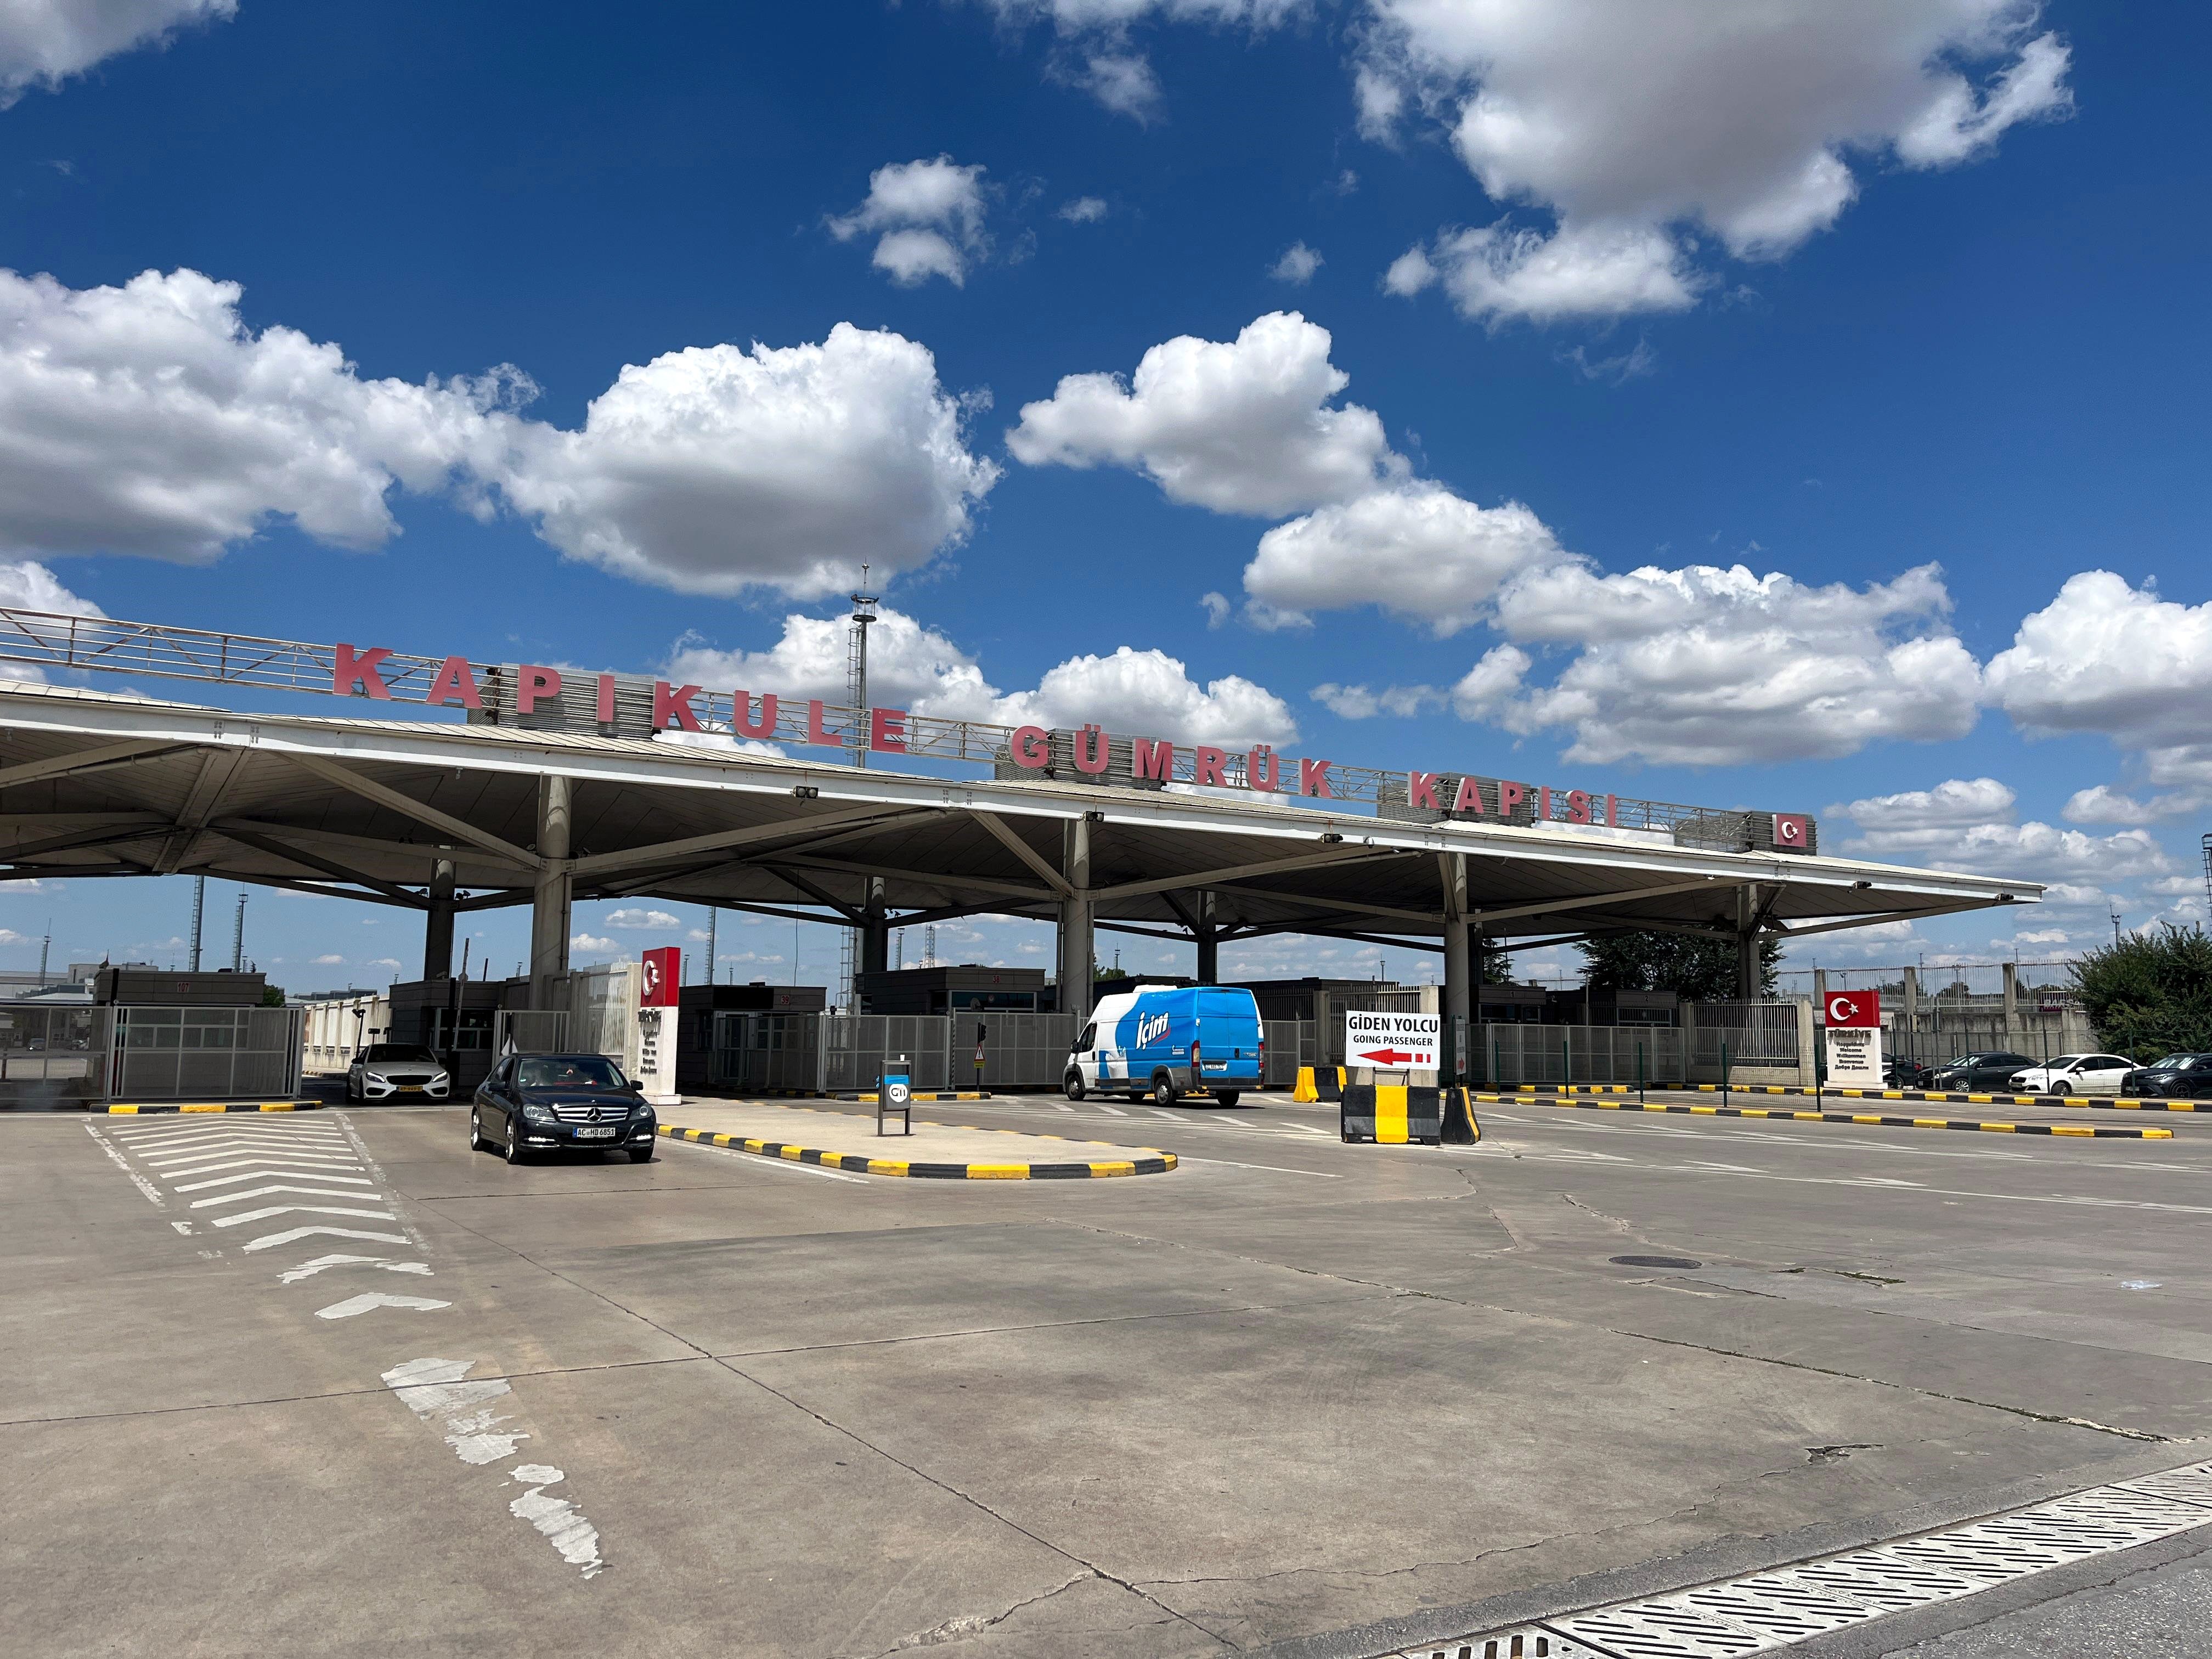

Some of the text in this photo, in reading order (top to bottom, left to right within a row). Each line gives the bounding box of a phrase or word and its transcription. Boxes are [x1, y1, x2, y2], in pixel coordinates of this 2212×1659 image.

[332, 643, 1616, 828] KAPIKULE GÜMRÜK KAPISI
[178, 983, 189, 992] 107
[781, 996, 789, 1004] 39
[1348, 1014, 1390, 1031] GİDEN
[1394, 1018, 1438, 1032] YOLCU
[1827, 1028, 1871, 1037] TÜRKİYE
[1353, 1035, 1433, 1046] GOING PASSENGER
